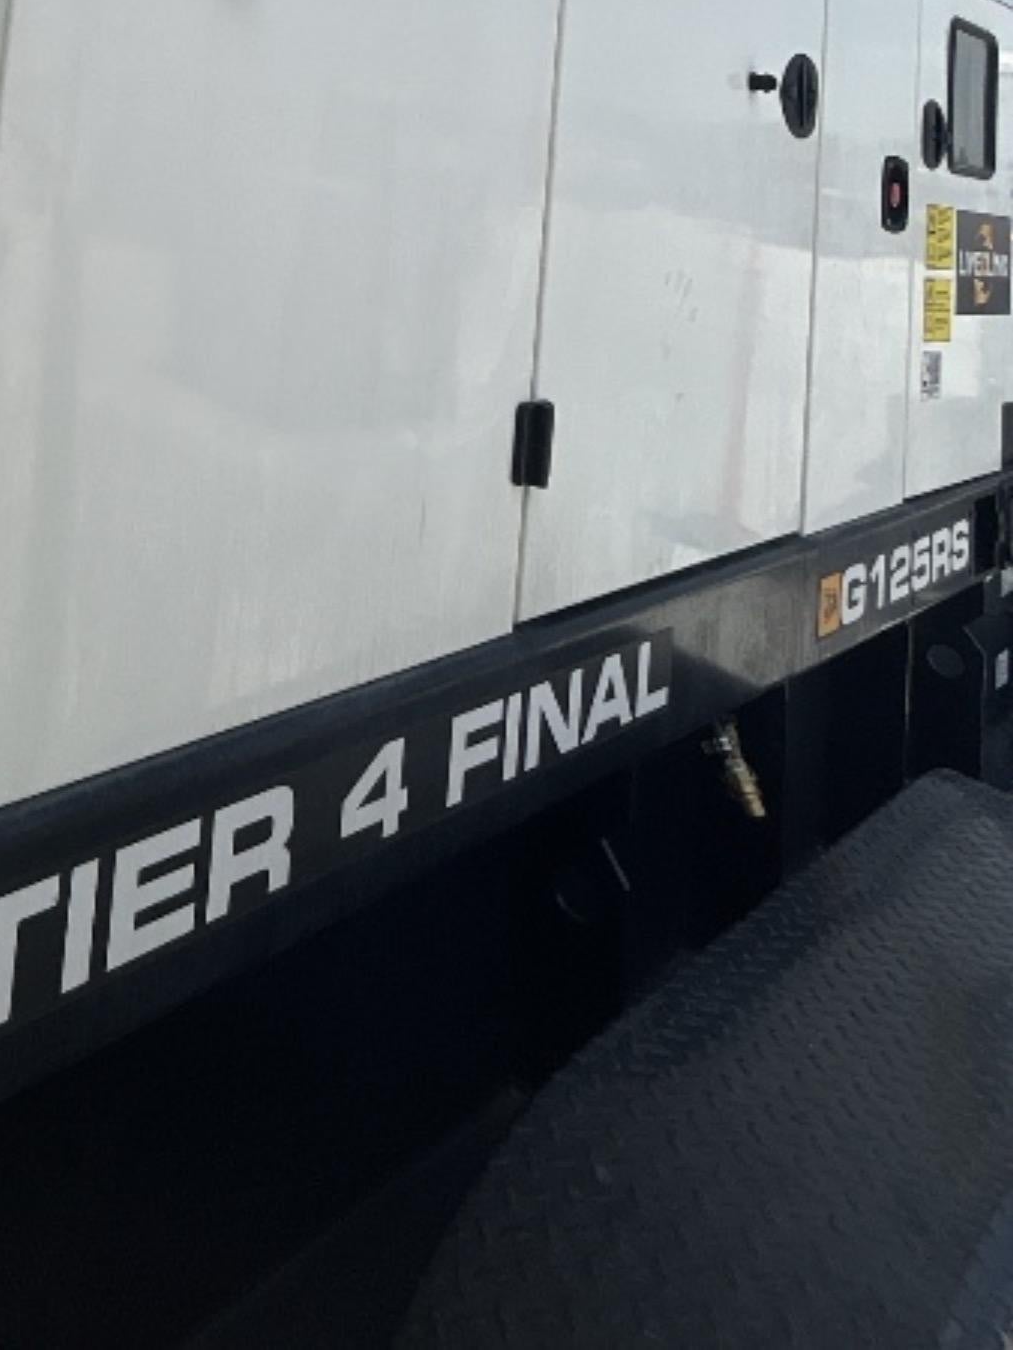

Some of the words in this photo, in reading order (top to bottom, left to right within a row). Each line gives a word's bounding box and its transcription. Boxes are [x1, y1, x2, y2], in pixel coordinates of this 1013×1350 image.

[842, 518, 969, 625] G125RS
[340, 737, 408, 839] 4
[443, 641, 670, 808] FINAL
